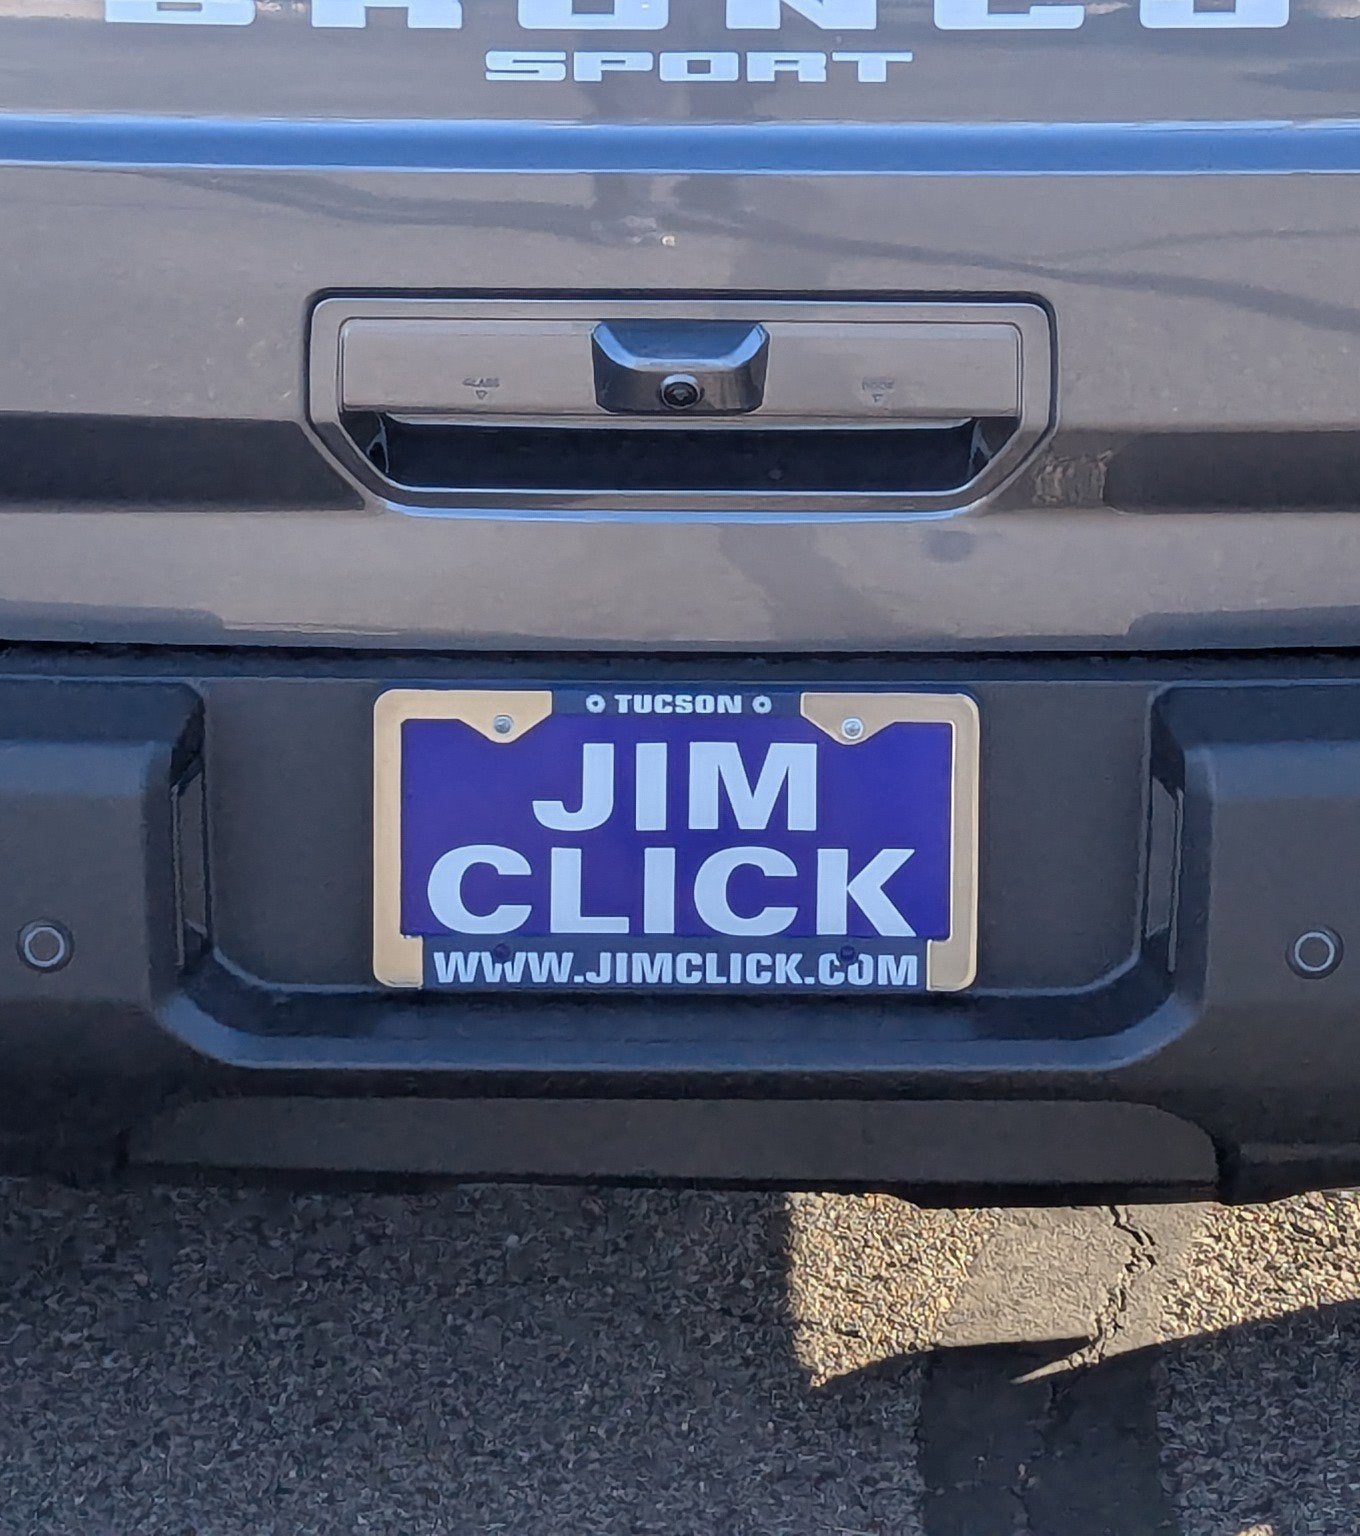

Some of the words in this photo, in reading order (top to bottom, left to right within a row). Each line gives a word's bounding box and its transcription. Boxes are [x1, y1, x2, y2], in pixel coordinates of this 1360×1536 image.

[485, 51, 913, 83] SPORT
[613, 694, 743, 715] TUCSON
[532, 741, 818, 832] JIM
[427, 844, 917, 937] CLICK
[433, 951, 918, 986] WWW.JIMCLICK.COM
